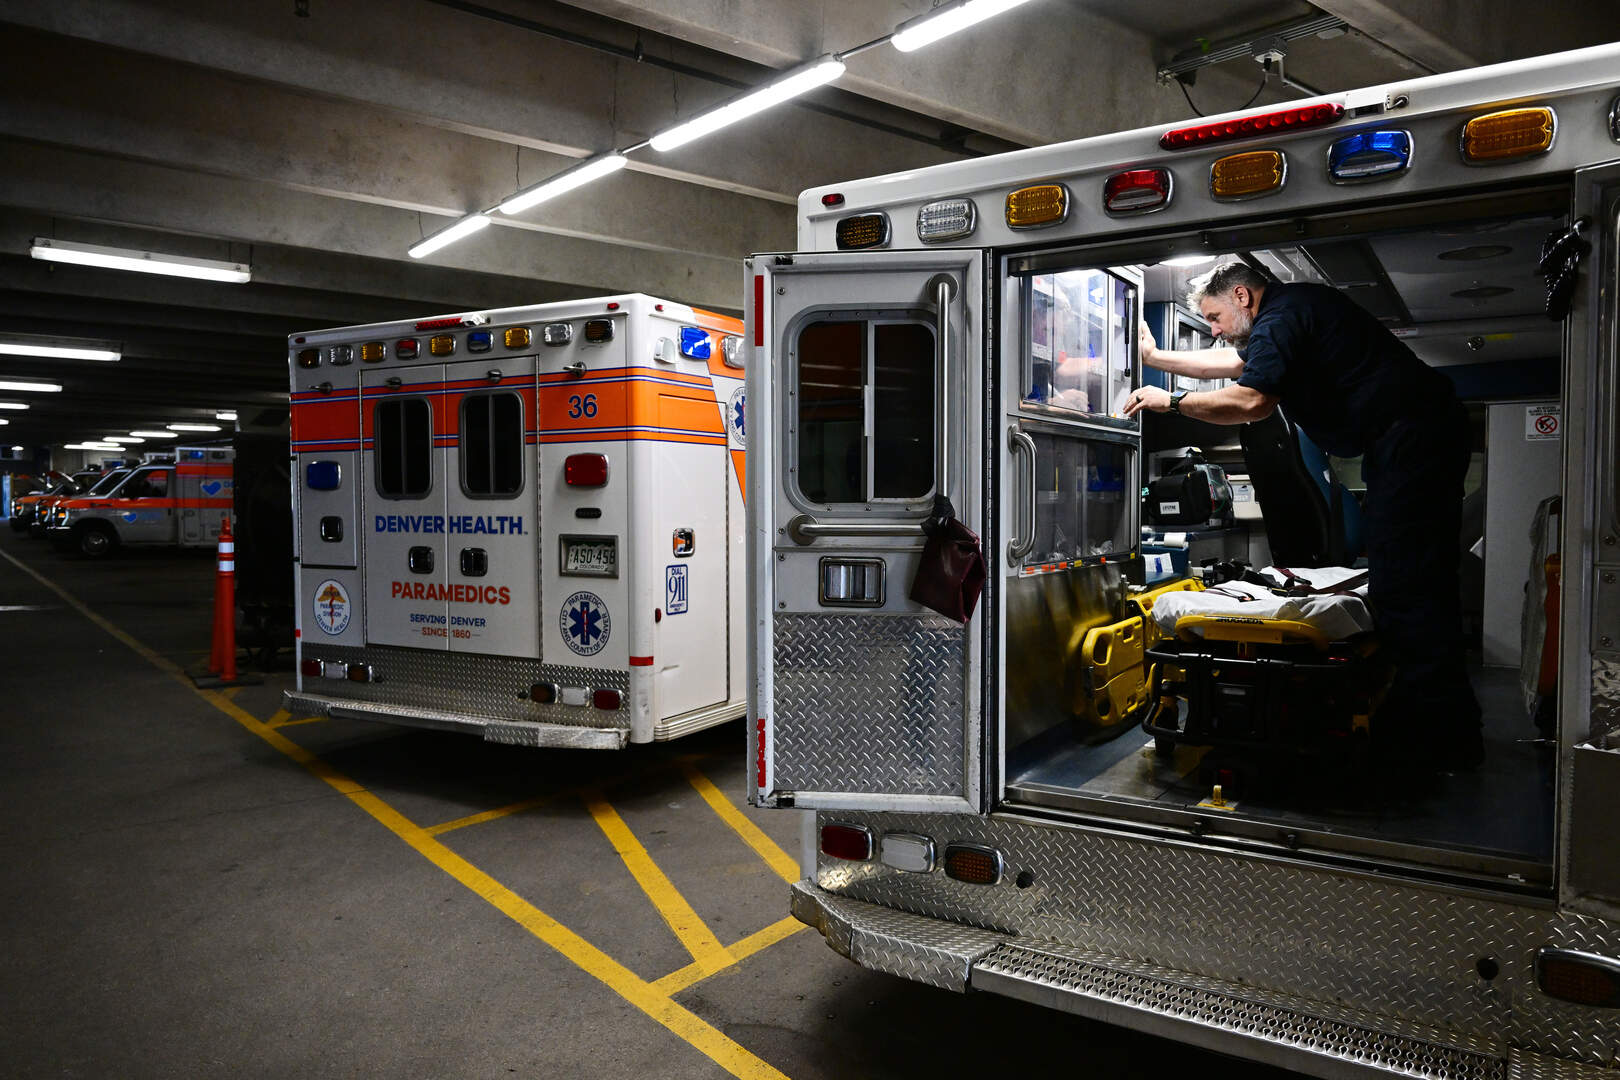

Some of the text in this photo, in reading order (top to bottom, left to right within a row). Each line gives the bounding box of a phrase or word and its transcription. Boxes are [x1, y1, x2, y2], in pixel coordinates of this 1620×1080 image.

[568, 394, 598, 419] 36
[375, 515, 522, 535] DENVER HEALTH
[671, 567, 683, 575] DIAL
[391, 581, 511, 605] PARAMEDICS
[668, 575, 685, 604] 911
[568, 593, 602, 609] PARAMEDIC
[410, 613, 486, 627] SERVING DENVER
[421, 626, 471, 639] SINCE 1860
[561, 609, 569, 626] CITY
[569, 641, 593, 653] COUNTY
[599, 612, 609, 643] DENVER
